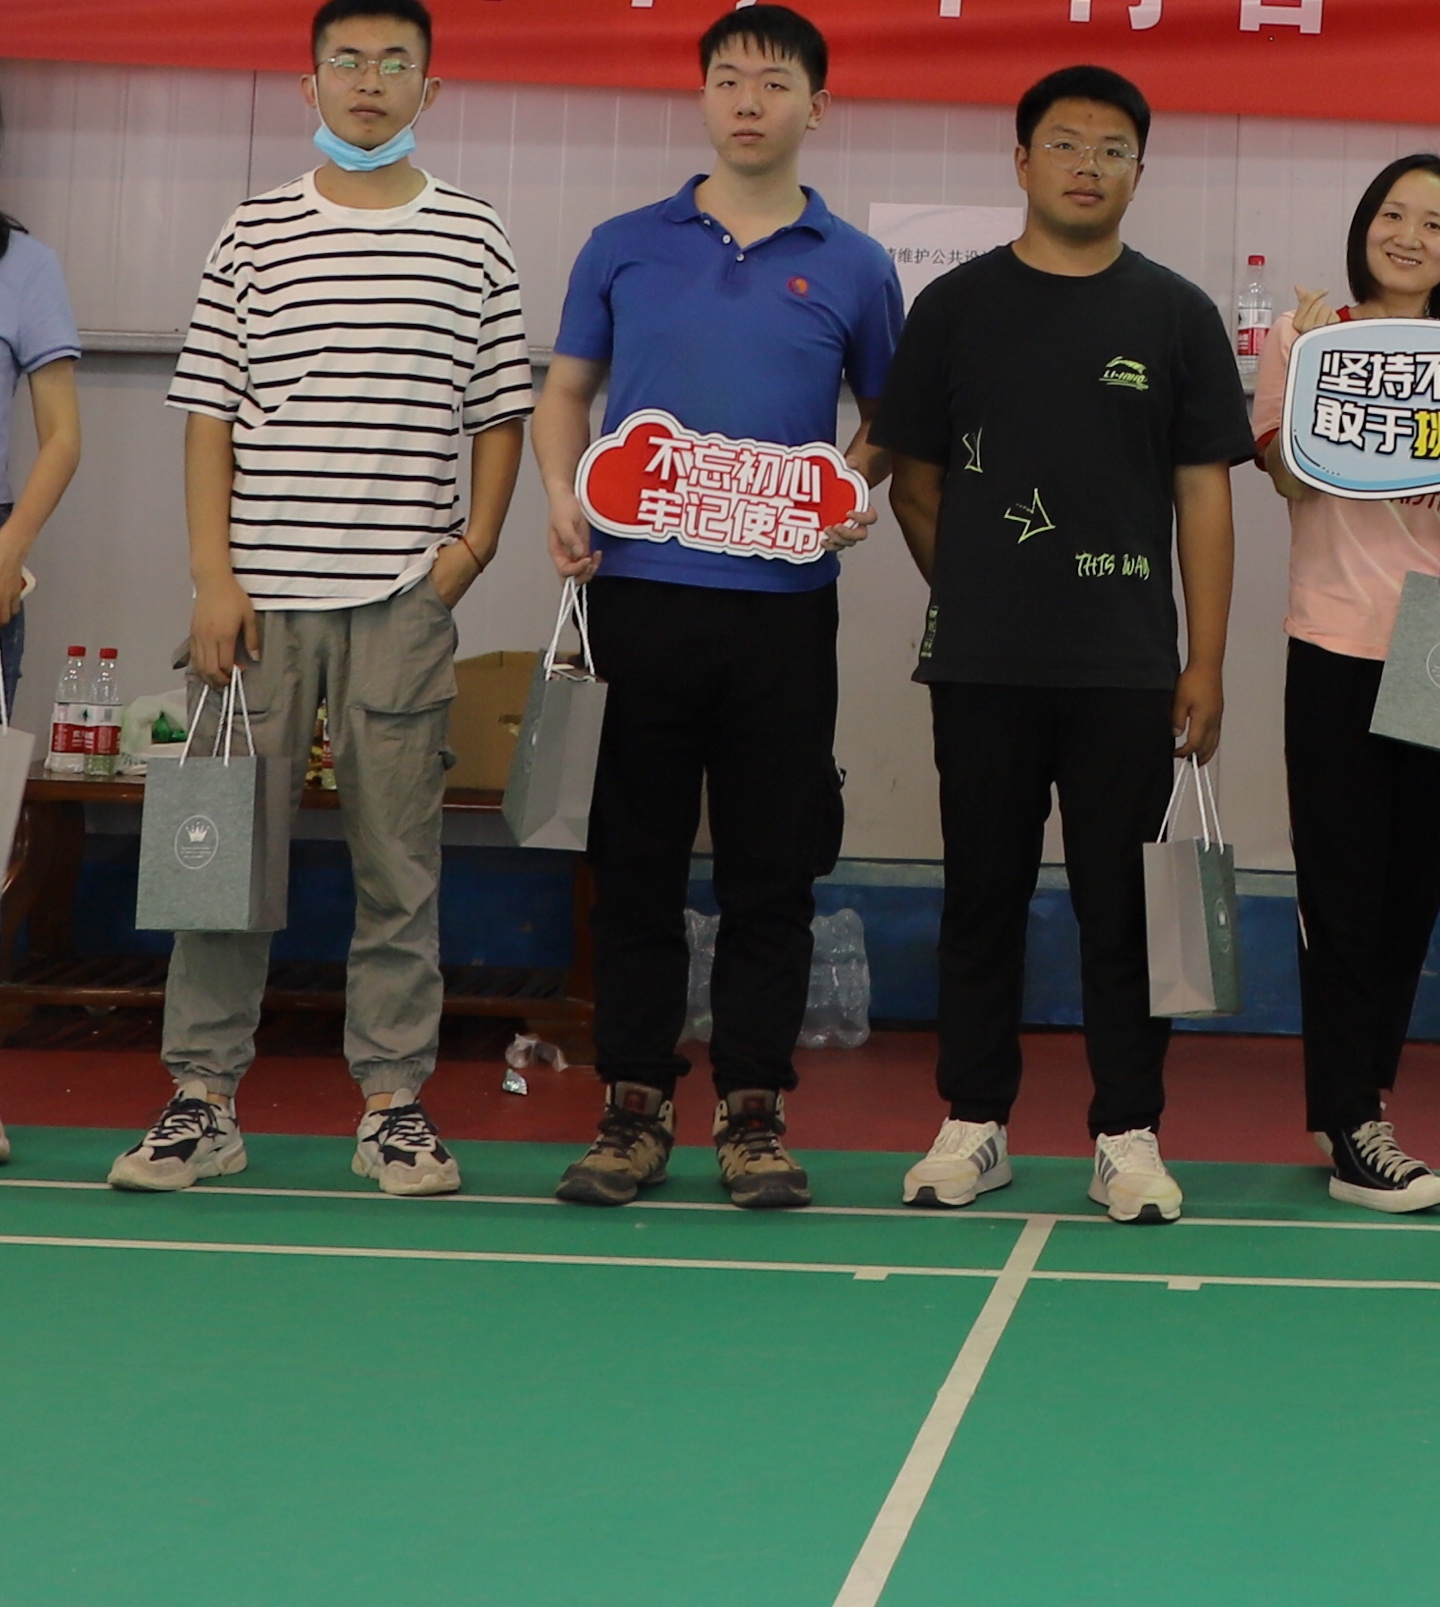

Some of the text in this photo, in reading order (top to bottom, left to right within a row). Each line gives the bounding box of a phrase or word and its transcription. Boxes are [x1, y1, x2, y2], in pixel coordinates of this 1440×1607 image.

[644, 435, 822, 504] 不忘初心
[636, 488, 822, 553] 牢记使命
[1075, 551, 1115, 577] THIS
